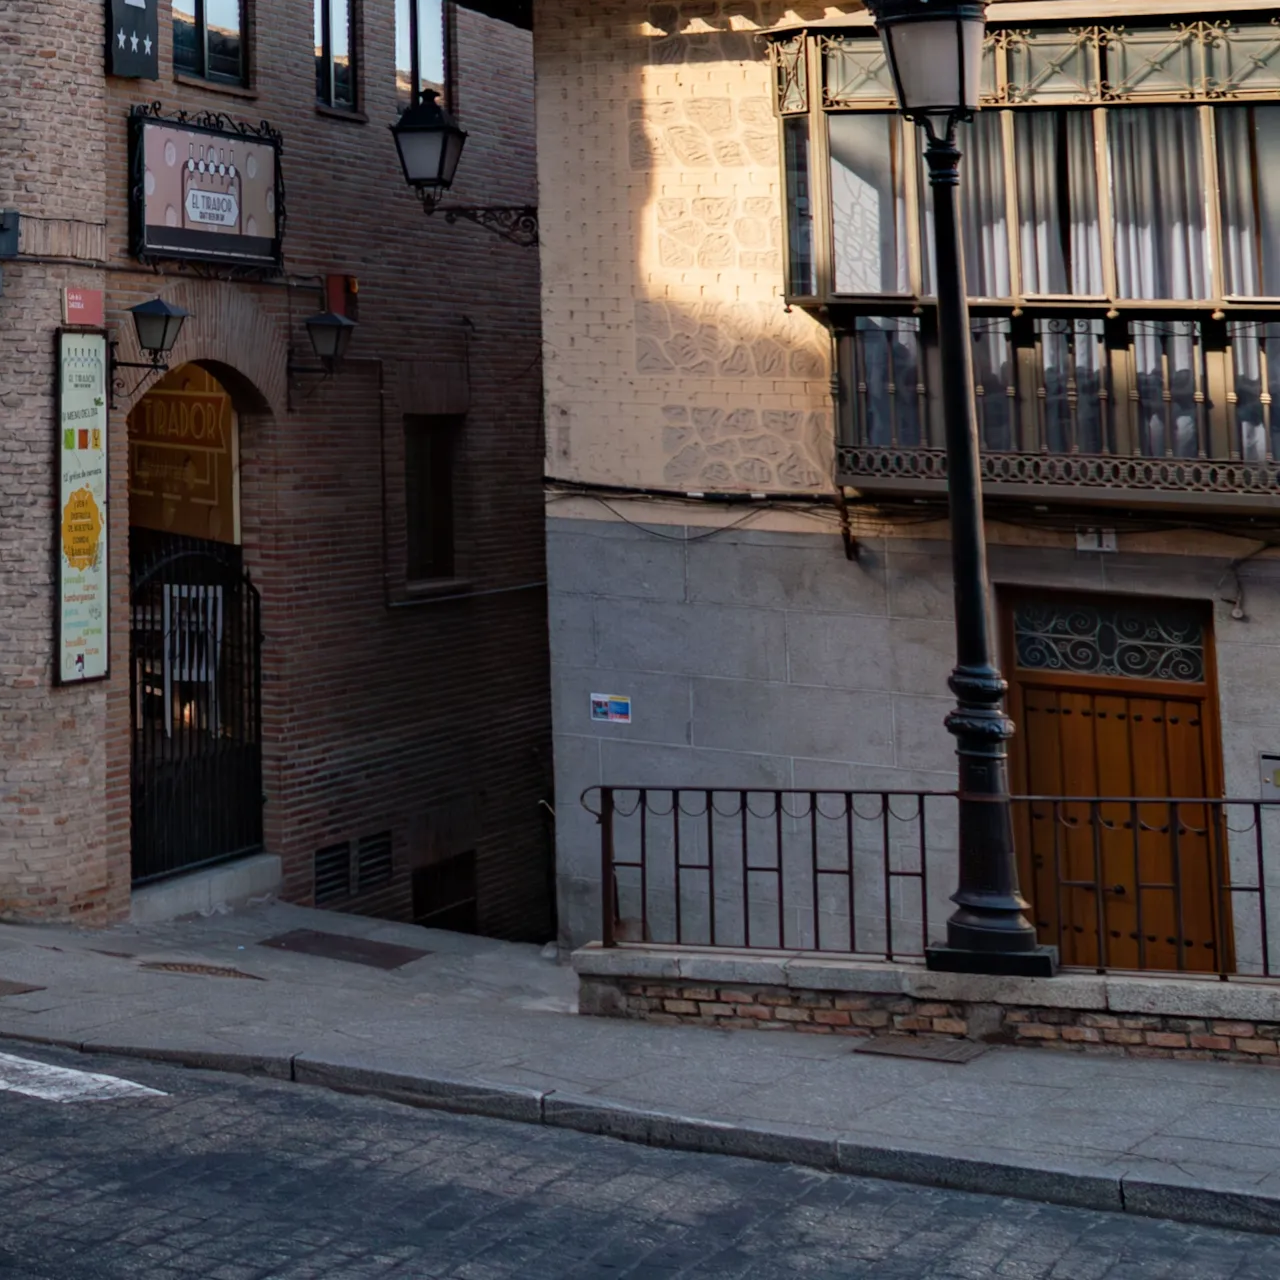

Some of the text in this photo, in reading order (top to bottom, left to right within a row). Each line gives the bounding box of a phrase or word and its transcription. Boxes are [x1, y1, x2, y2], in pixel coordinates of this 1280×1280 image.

[192, 193, 233, 213] EL TIRADOR
[142, 399, 216, 439] TIRADOR
